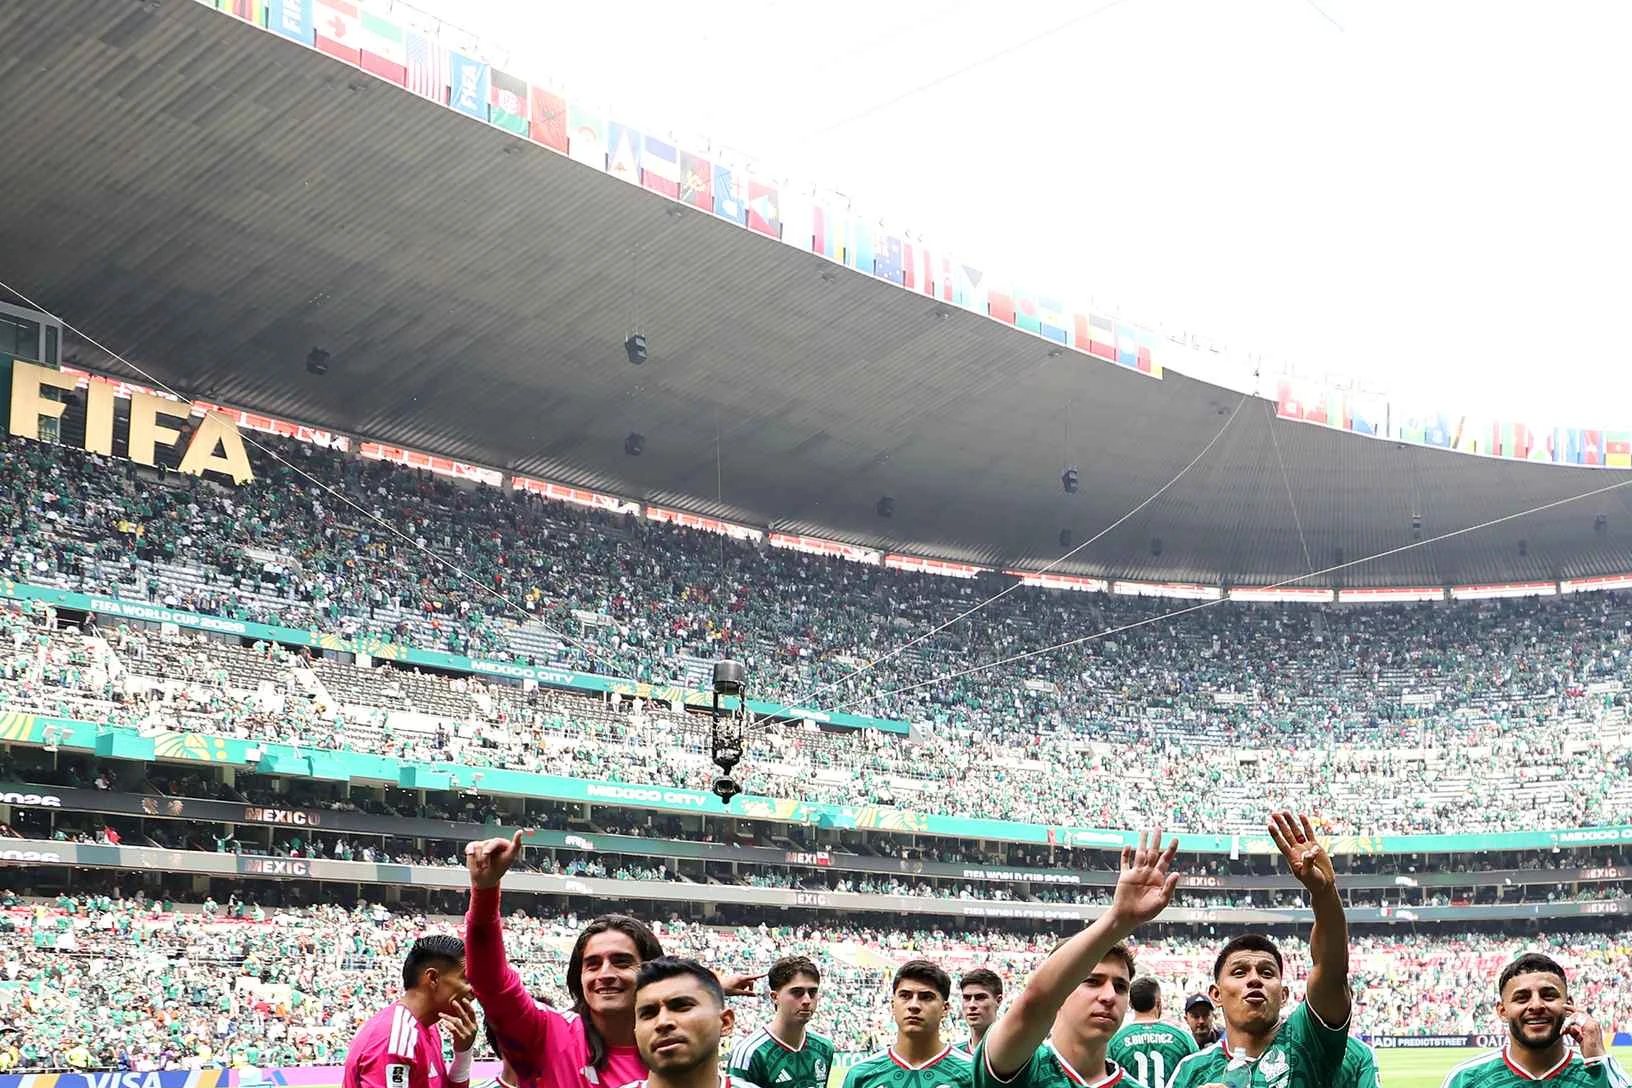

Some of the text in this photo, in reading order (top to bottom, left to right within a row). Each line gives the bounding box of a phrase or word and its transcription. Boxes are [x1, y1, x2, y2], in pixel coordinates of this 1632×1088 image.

[9, 360, 256, 486] FIFA
[91, 599, 121, 613] FIFA
[123, 604, 172, 621] WORLD
[172, 611, 199, 626] CUP
[471, 660, 574, 684] MEXICO CITY
[587, 784, 707, 805] MEXICO CITY
[1562, 830, 1620, 842] MEXICO
[1398, 1037, 1468, 1047] PREDICTSTREET
[1476, 1035, 1511, 1048] QATA
